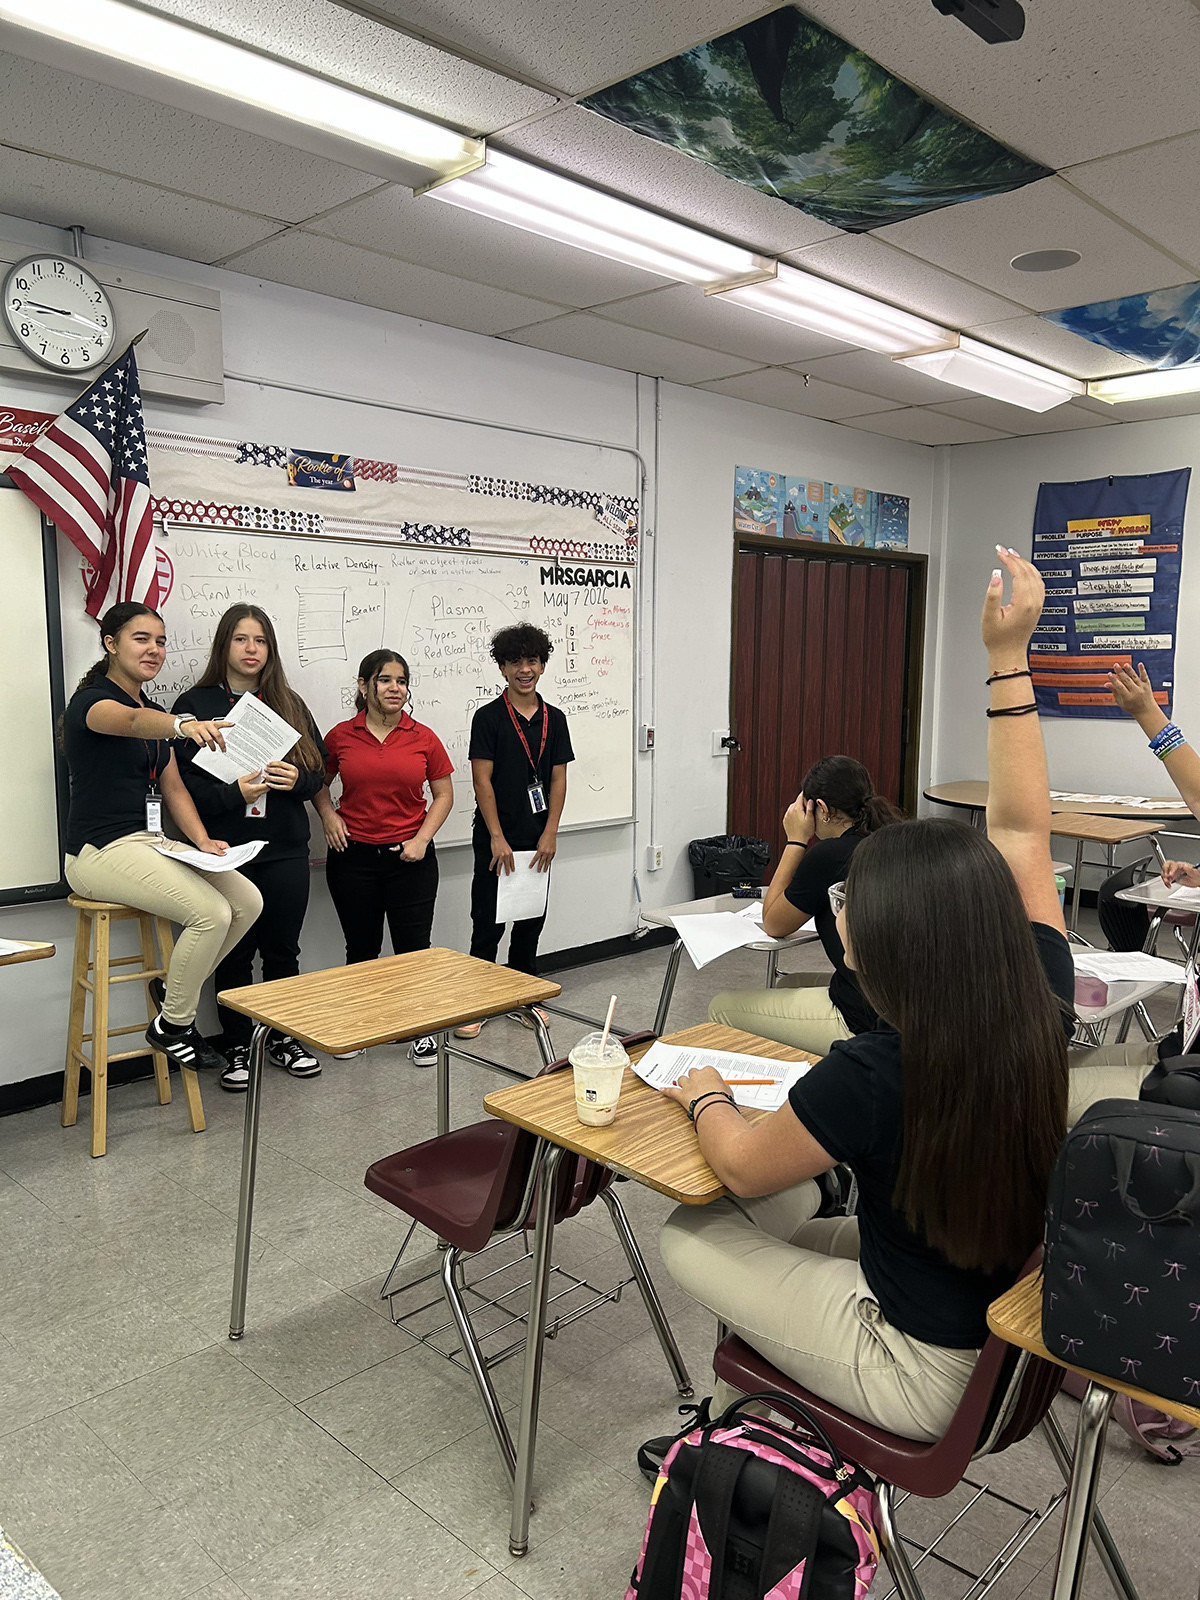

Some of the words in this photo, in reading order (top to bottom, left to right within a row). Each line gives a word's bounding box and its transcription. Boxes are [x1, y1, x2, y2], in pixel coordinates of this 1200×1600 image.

[32, 263, 41, 276] 11
[53, 262, 65, 275] 12
[15, 278, 28, 290] 10
[79, 274, 84, 285] 1
[94, 291, 102, 304] 2
[100, 315, 108, 328] 3
[20, 323, 30, 336] 8
[94, 336, 104, 347] 4
[39, 343, 47, 355] 7
[60, 352, 70, 364] 6
[83, 350, 90, 362] 5
[294, 455, 333, 474] Rookie
[333, 461, 347, 482] of
[309, 475, 321, 484] The
[605, 500, 629, 525] WELCOME
[175, 541, 232, 560] White
[238, 541, 277, 560] Blood
[294, 554, 340, 572] Relative
[237, 582, 258, 598] the
[1083, 580, 1105, 591] Steps
[430, 595, 485, 617] Plasma
[543, 591, 570, 617] May
[570, 590, 581, 606] 7
[583, 586, 610, 607] 2026
[412, 624, 425, 643] 3
[425, 627, 457, 645] Types
[424, 644, 442, 660] Red
[444, 643, 466, 656] Blood
[475, 685, 493, 697] The
